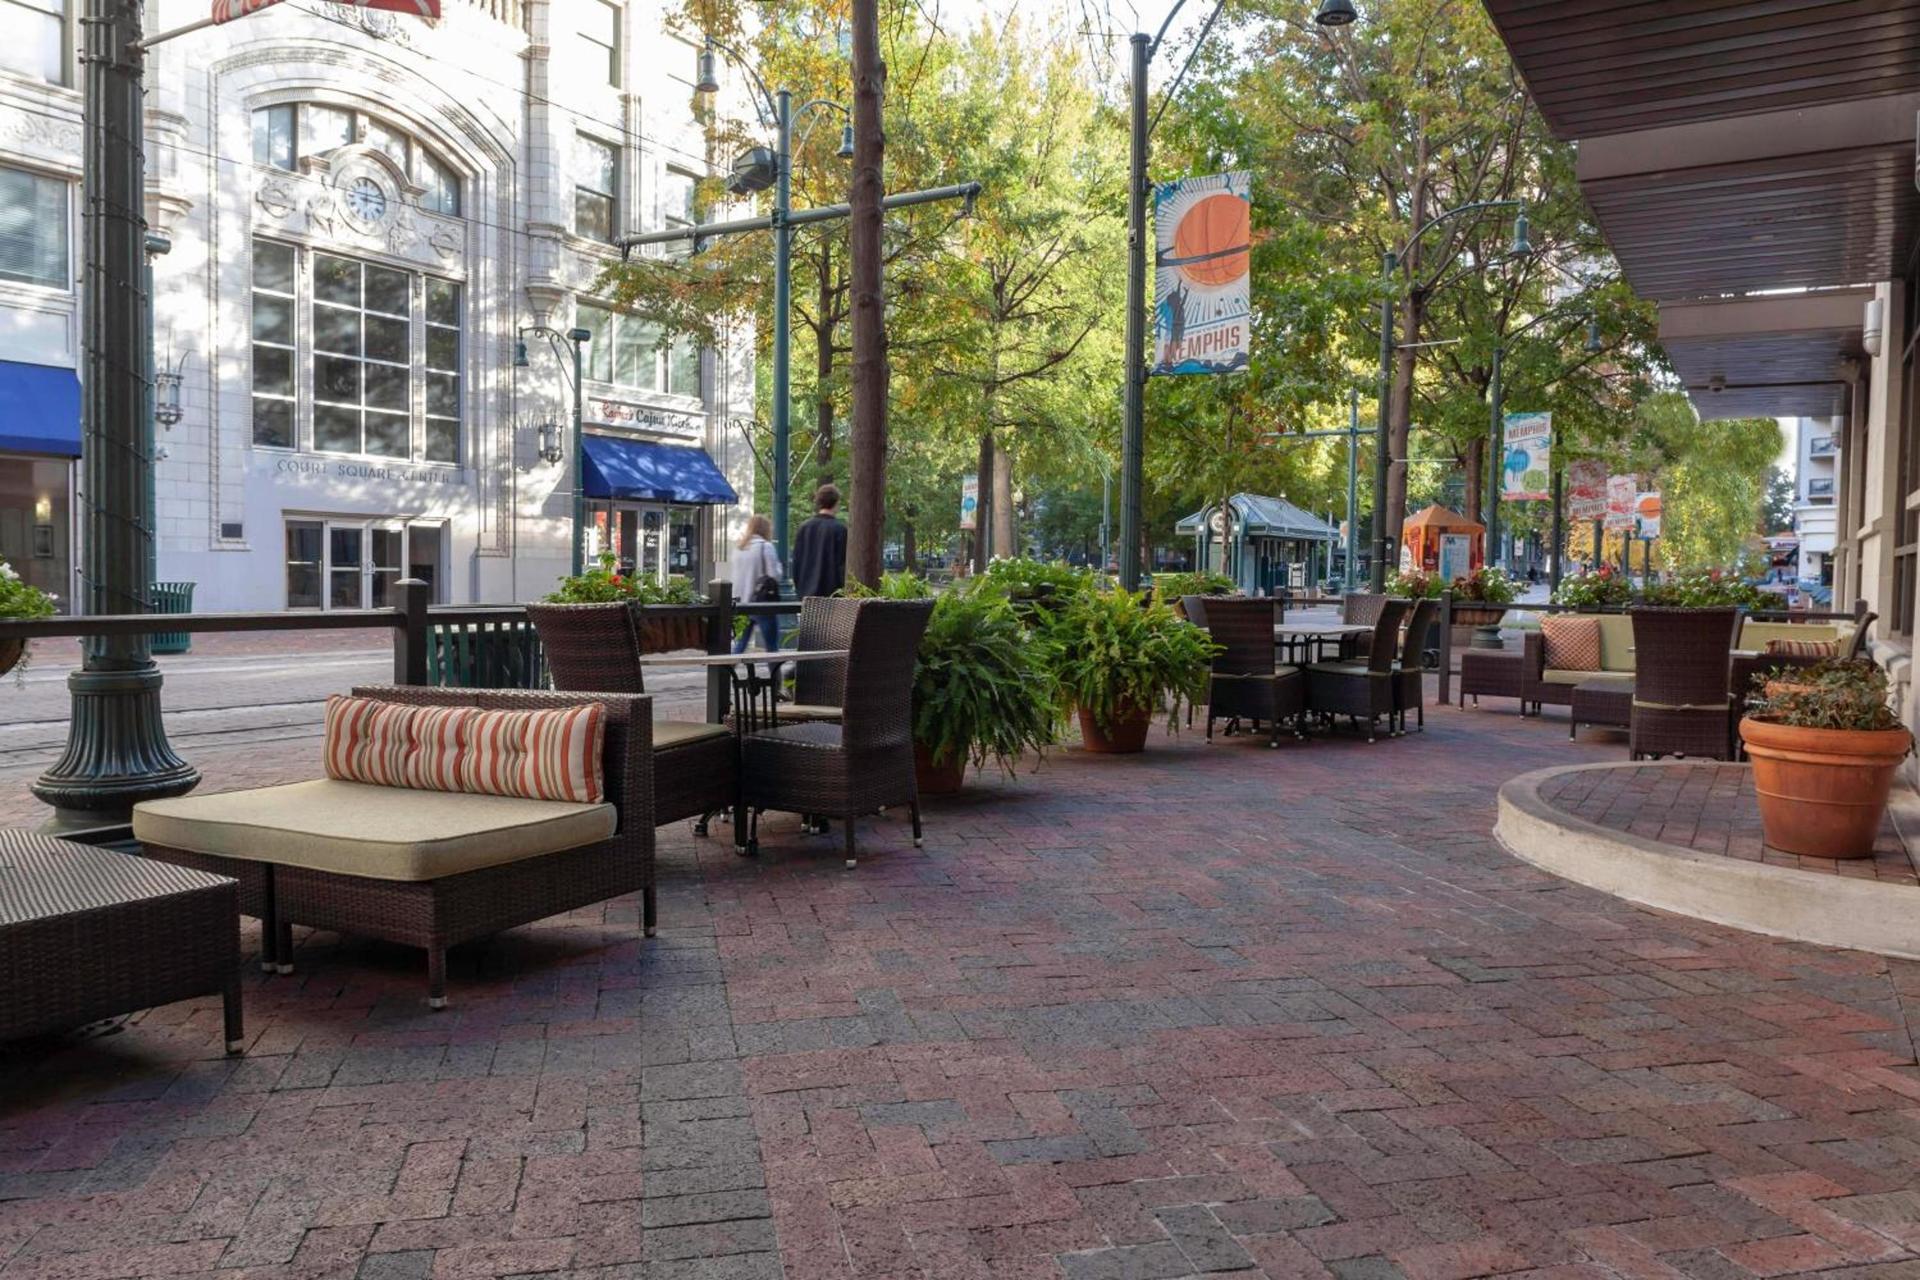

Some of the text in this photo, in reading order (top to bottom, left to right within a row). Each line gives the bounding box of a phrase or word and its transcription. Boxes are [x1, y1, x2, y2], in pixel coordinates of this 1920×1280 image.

[1163, 325, 1241, 363] MEMPHIS
[635, 409, 665, 426] Cajun
[1508, 422, 1547, 439] MEMPHIS
[276, 459, 328, 475] COURT
[337, 464, 392, 480] SQUARE
